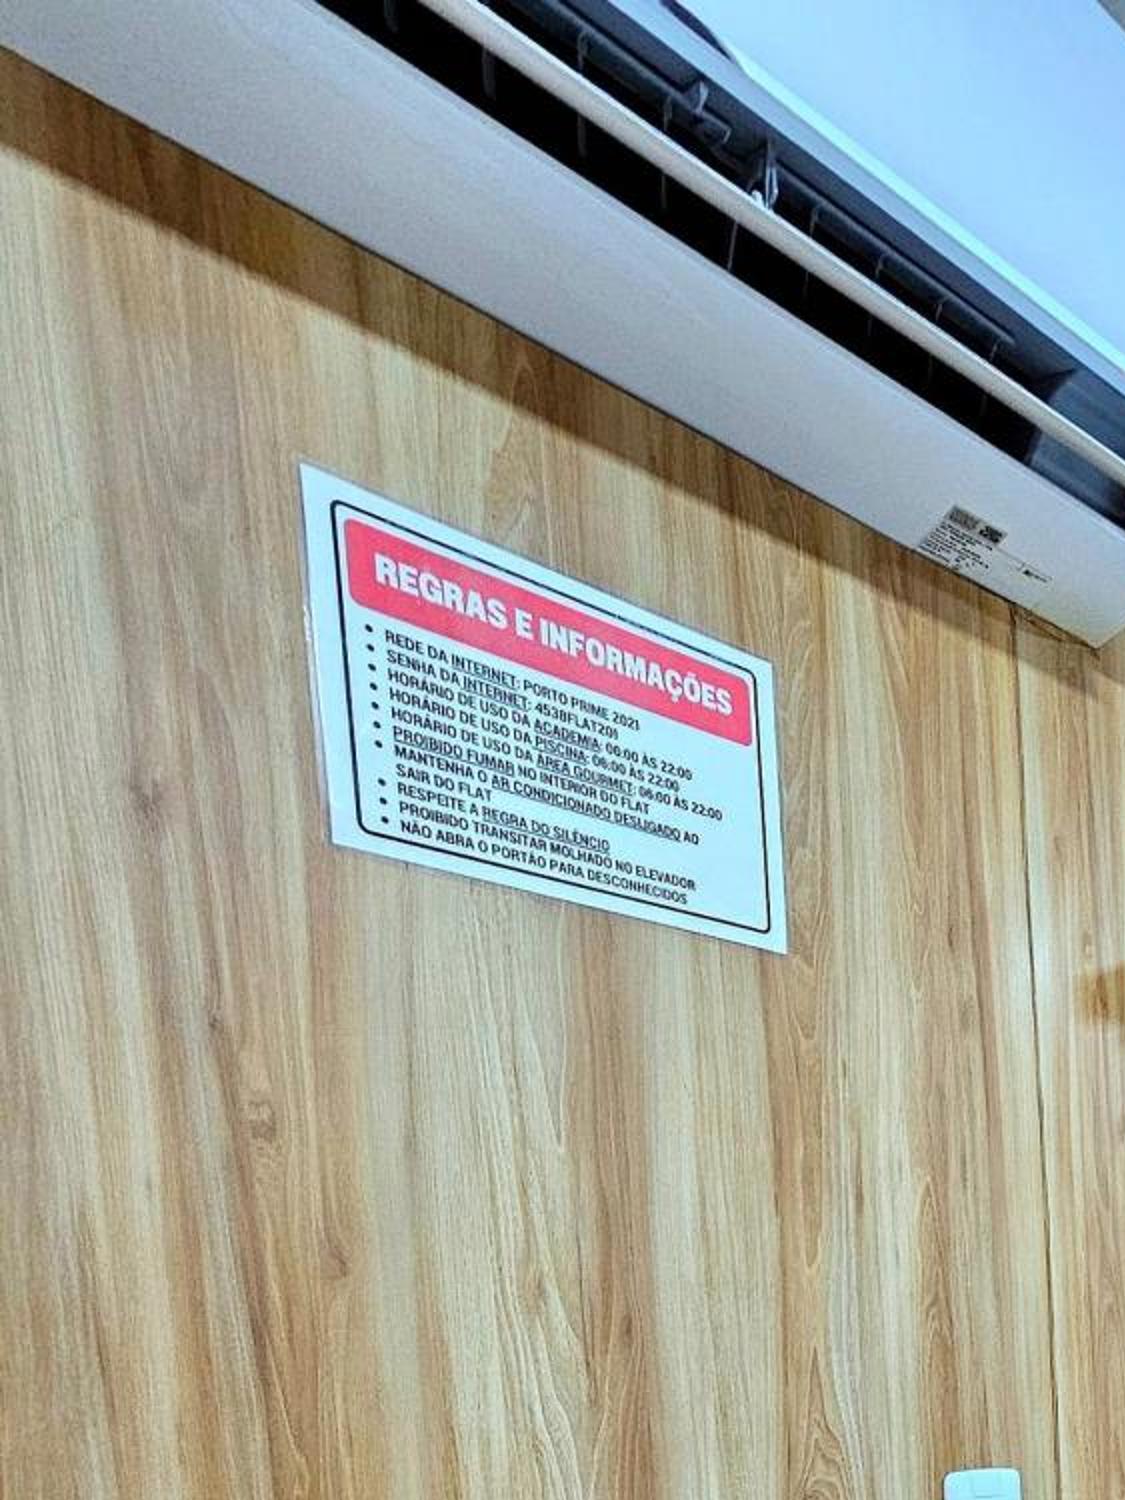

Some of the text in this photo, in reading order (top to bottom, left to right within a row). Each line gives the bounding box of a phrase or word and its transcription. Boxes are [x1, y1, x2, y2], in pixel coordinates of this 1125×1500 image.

[374, 552, 732, 716] REGRAS E INFORMAÇÕES
[386, 648, 435, 678] SENHA
[439, 666, 459, 686] DA
[462, 674, 530, 710] INTERNET:
[384, 629, 639, 731] REDE DA INTERNET: PORTO PRIME 2021
[388, 667, 454, 702] HORÁRIO
[457, 691, 475, 709] DE
[479, 698, 509, 720] USO
[511, 709, 530, 727] DA
[389, 687, 455, 720] HORÁRIO
[458, 709, 477, 728] DE
[481, 717, 510, 738] USO
[513, 727, 531, 745] DA
[391, 706, 456, 739] HORÁRIO
[460, 728, 479, 746] DE
[482, 735, 511, 756] USO
[514, 745, 532, 763] DA
[691, 802, 722, 822] 22:00
[393, 725, 649, 815] PROIBIDO FUMAR NO INTERIOR DO FLAT
[394, 744, 699, 846] MANTENHA O AR CONDICIONADO DESLIGADO AO
[396, 763, 492, 803] SAIR DO FLAT
[397, 781, 610, 852] RESPEITE A REGRA DO SILÊNCIO
[399, 800, 695, 892] PROIBIDO TRANSITAR MOLHADO NO ELEVADOR
[400, 815, 687, 905] NÃO ABRA O PORTÃO PARA DESCONHECIDOS
